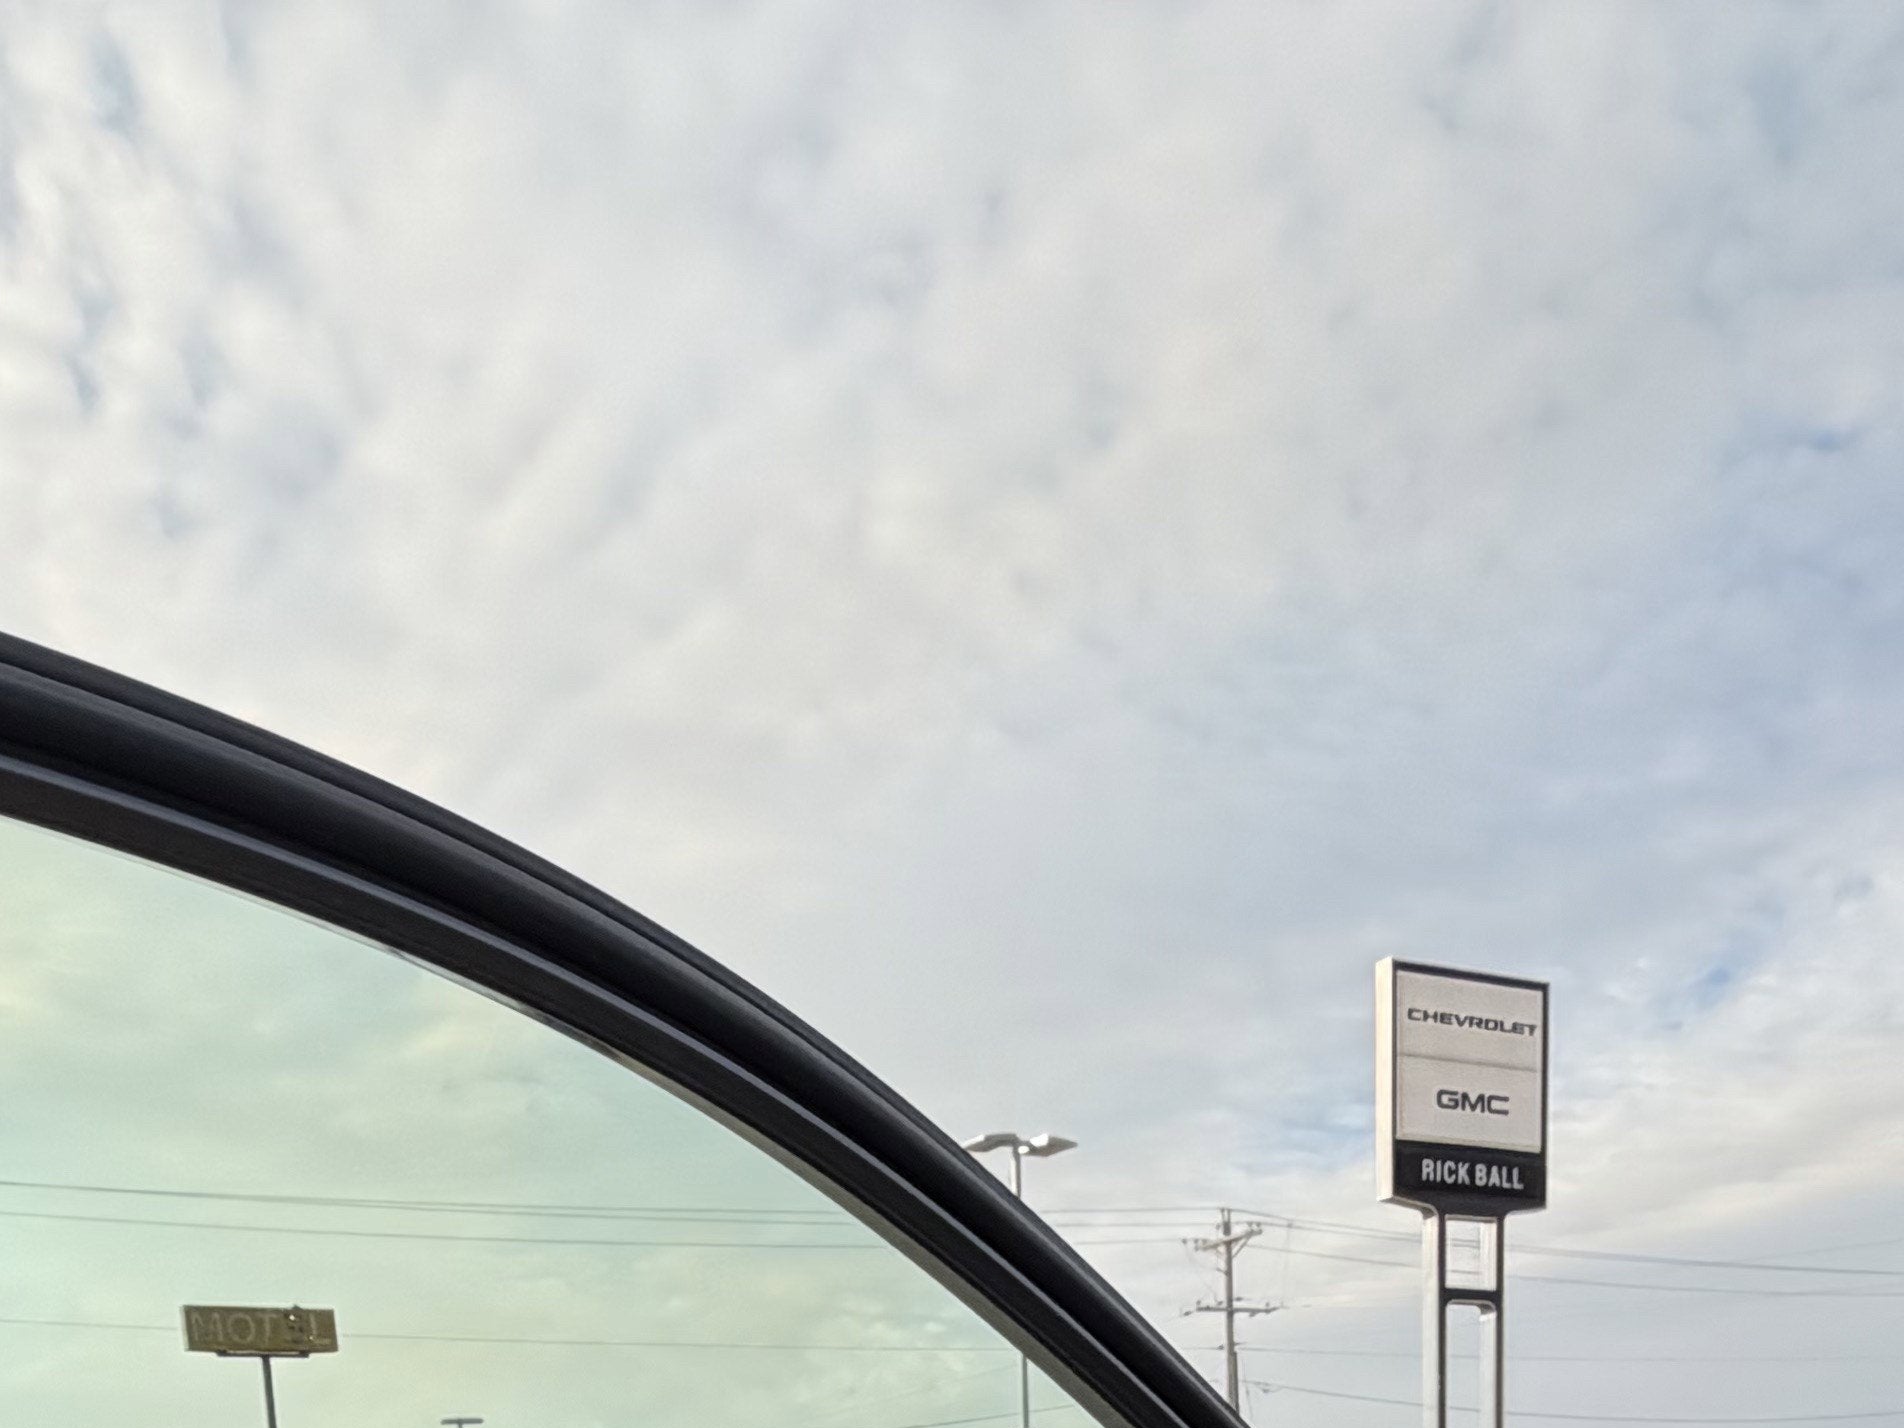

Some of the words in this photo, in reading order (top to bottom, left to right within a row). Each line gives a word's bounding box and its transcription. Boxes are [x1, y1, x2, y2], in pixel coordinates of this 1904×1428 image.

[1407, 1007, 1537, 1036] CHEVROLET
[1436, 1088, 1510, 1116] GMC
[1421, 1158, 1469, 1185] RICK
[1475, 1163, 1524, 1190] BALL
